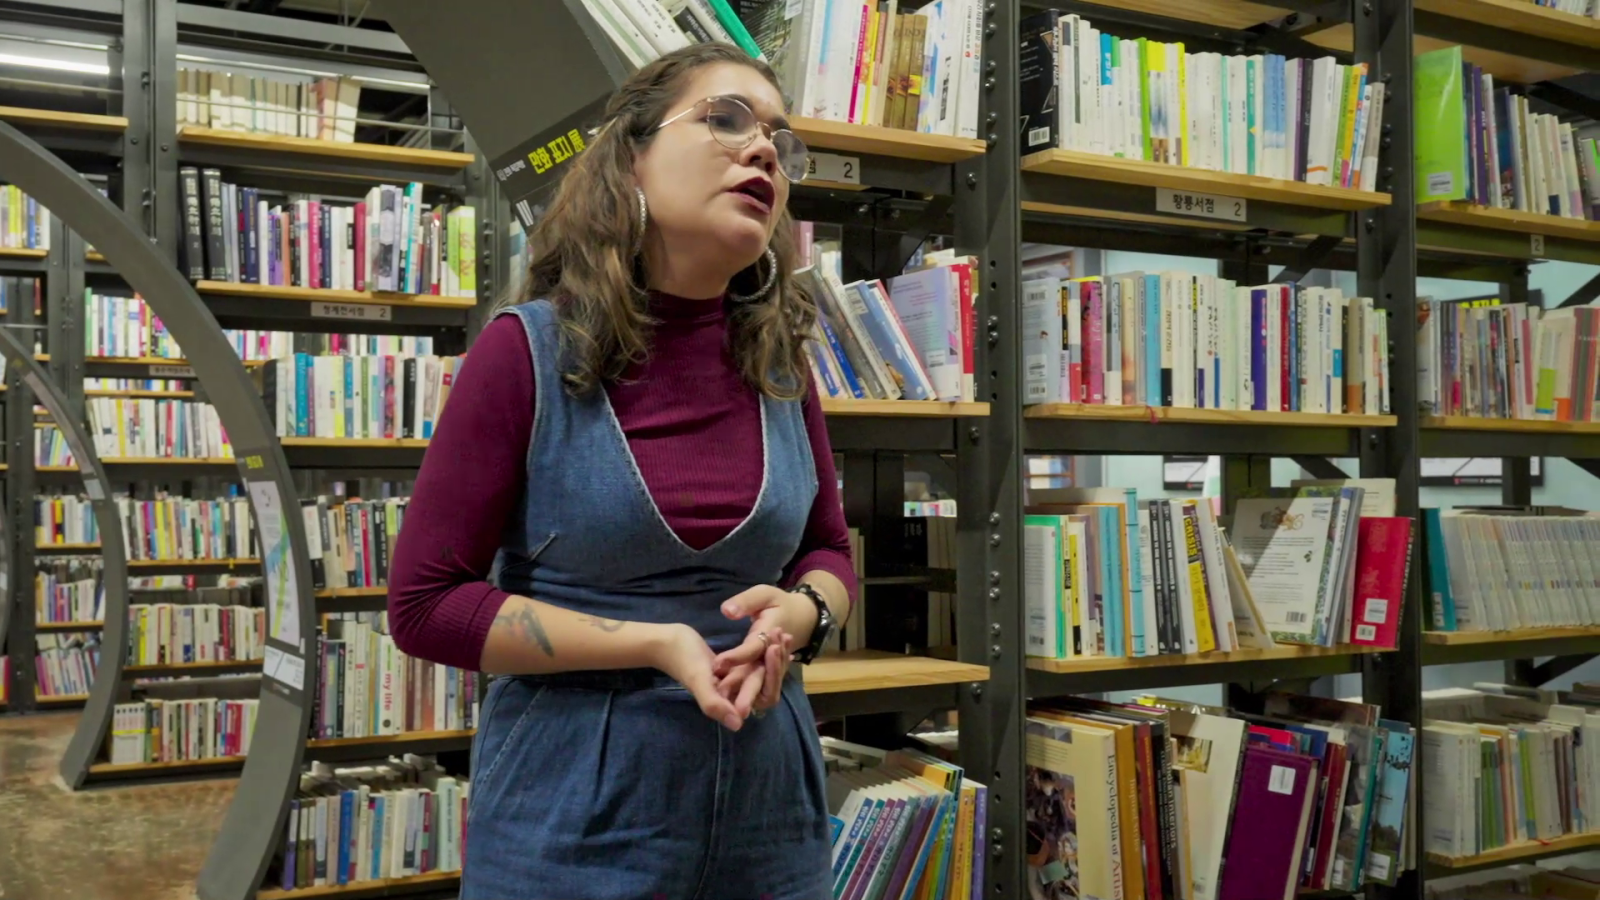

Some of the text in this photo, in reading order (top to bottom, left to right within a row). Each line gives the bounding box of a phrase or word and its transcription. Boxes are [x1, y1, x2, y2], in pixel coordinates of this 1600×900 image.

[527, 147, 553, 174] 만화
[547, 136, 573, 164] 표지
[843, 162, 853, 179] 2
[1234, 202, 1242, 217] 2
[1534, 238, 1541, 252] 2
[379, 308, 386, 318] 2
[1184, 518, 1198, 556] CRISIS
[383, 673, 392, 711] my life
[1106, 754, 1119, 842] Encyclopedia
[1166, 762, 1177, 848] Indian Interiors
[1111, 843, 1119, 856] of
